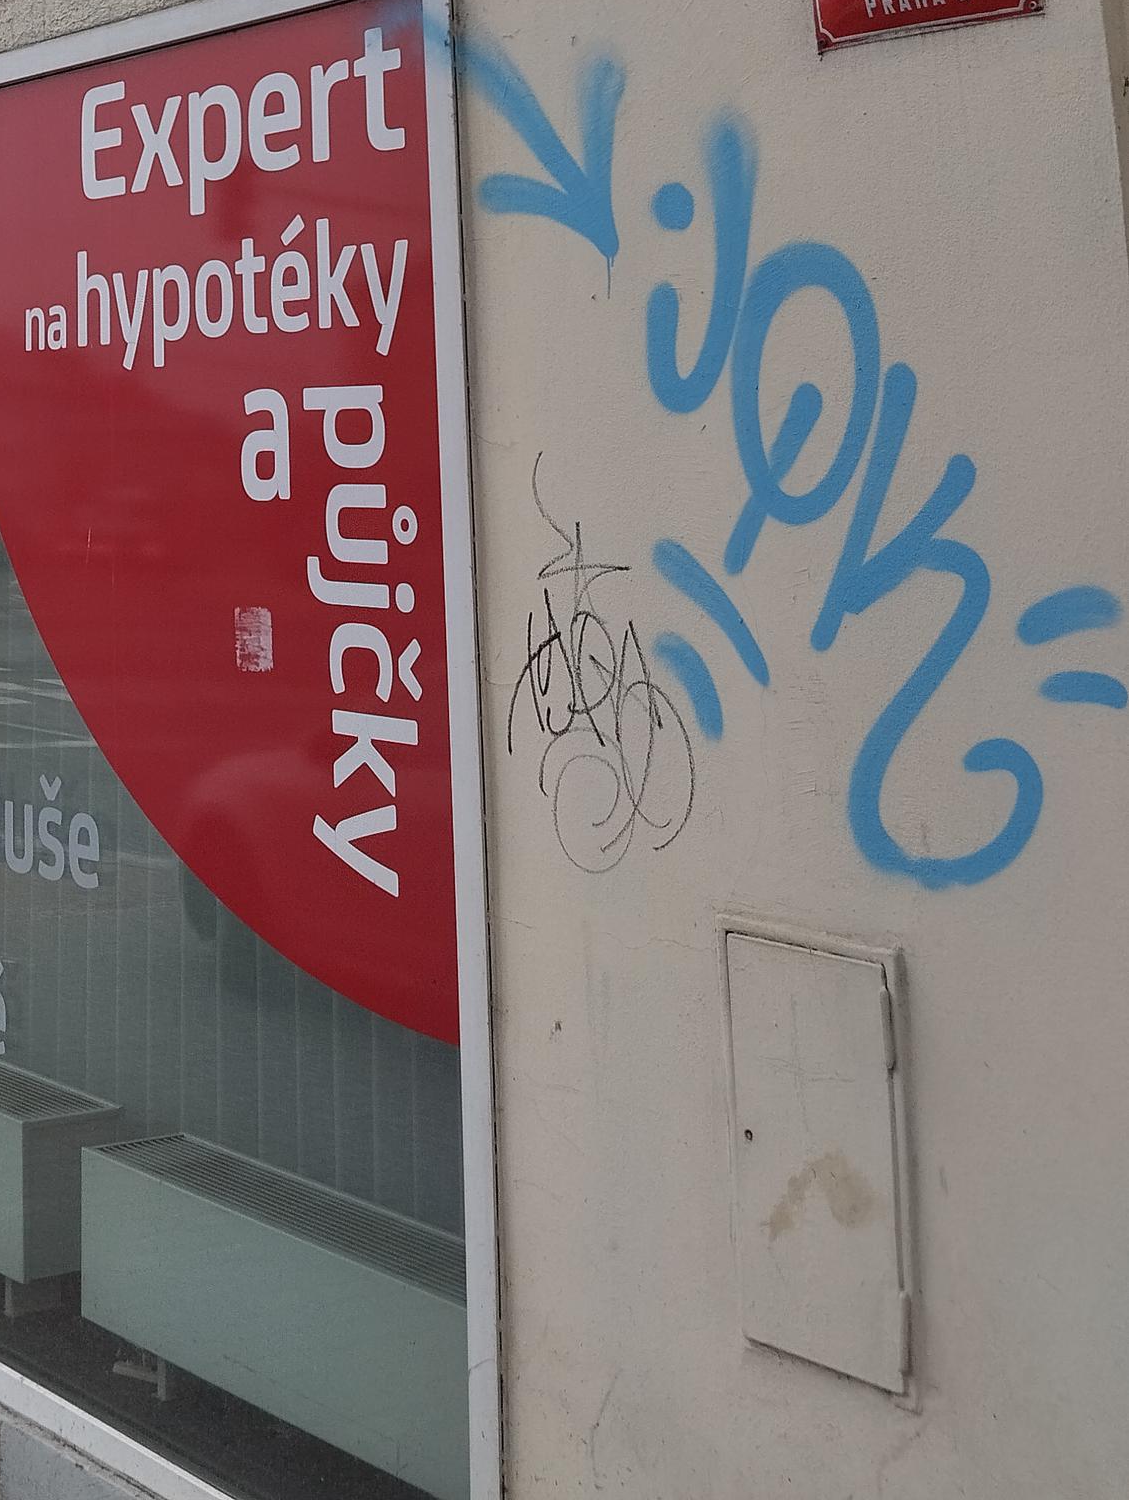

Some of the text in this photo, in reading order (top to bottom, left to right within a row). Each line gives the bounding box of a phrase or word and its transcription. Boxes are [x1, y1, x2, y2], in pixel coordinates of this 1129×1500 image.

[81, 26, 406, 216] Expert
[25, 214, 409, 371] na hypotéky
[241, 387, 291, 501] a
[303, 384, 422, 898] půjčky
